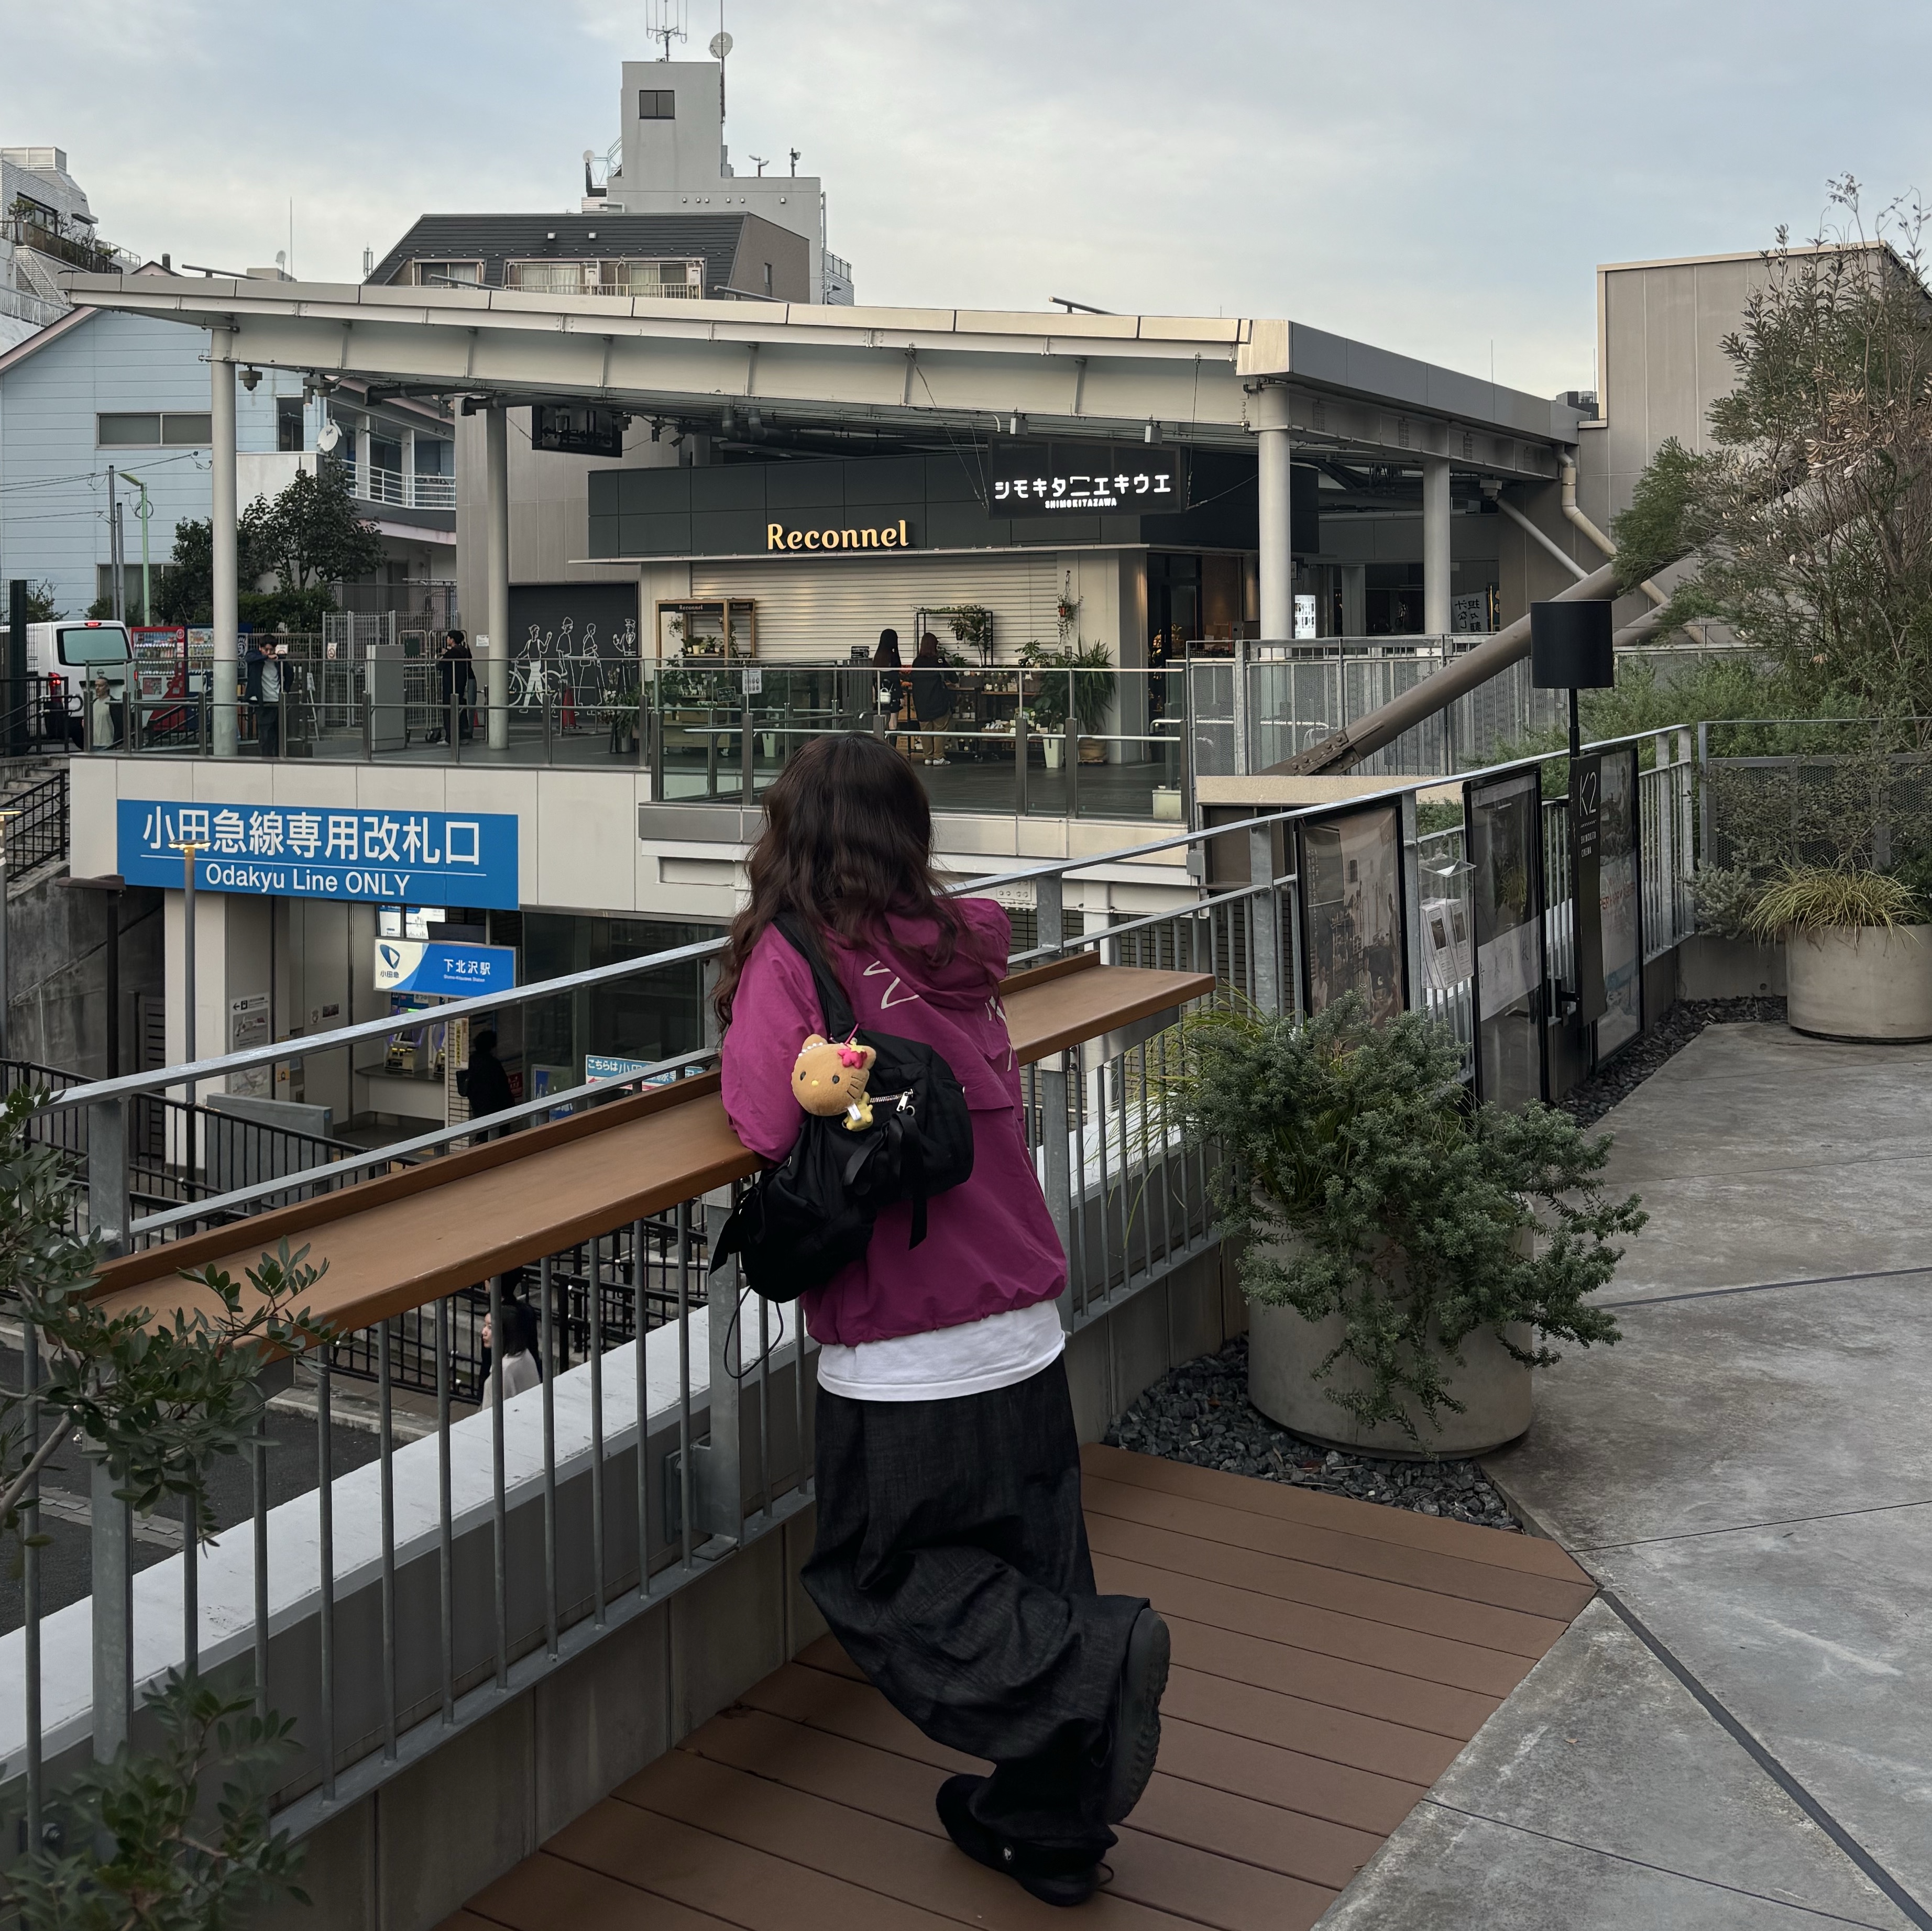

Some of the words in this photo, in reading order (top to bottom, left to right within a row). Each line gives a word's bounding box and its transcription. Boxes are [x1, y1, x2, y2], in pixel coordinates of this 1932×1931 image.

[1044, 497, 1117, 509] SHIMOKITAZAWA
[767, 520, 909, 550] Reconnel
[1579, 771, 1597, 816] K2
[142, 805, 480, 865] 小田急線専用改札口
[206, 863, 284, 893] Odakyu
[293, 868, 338, 892] Line
[345, 870, 411, 896] ONLY
[443, 958, 490, 976] 下北沢駅
